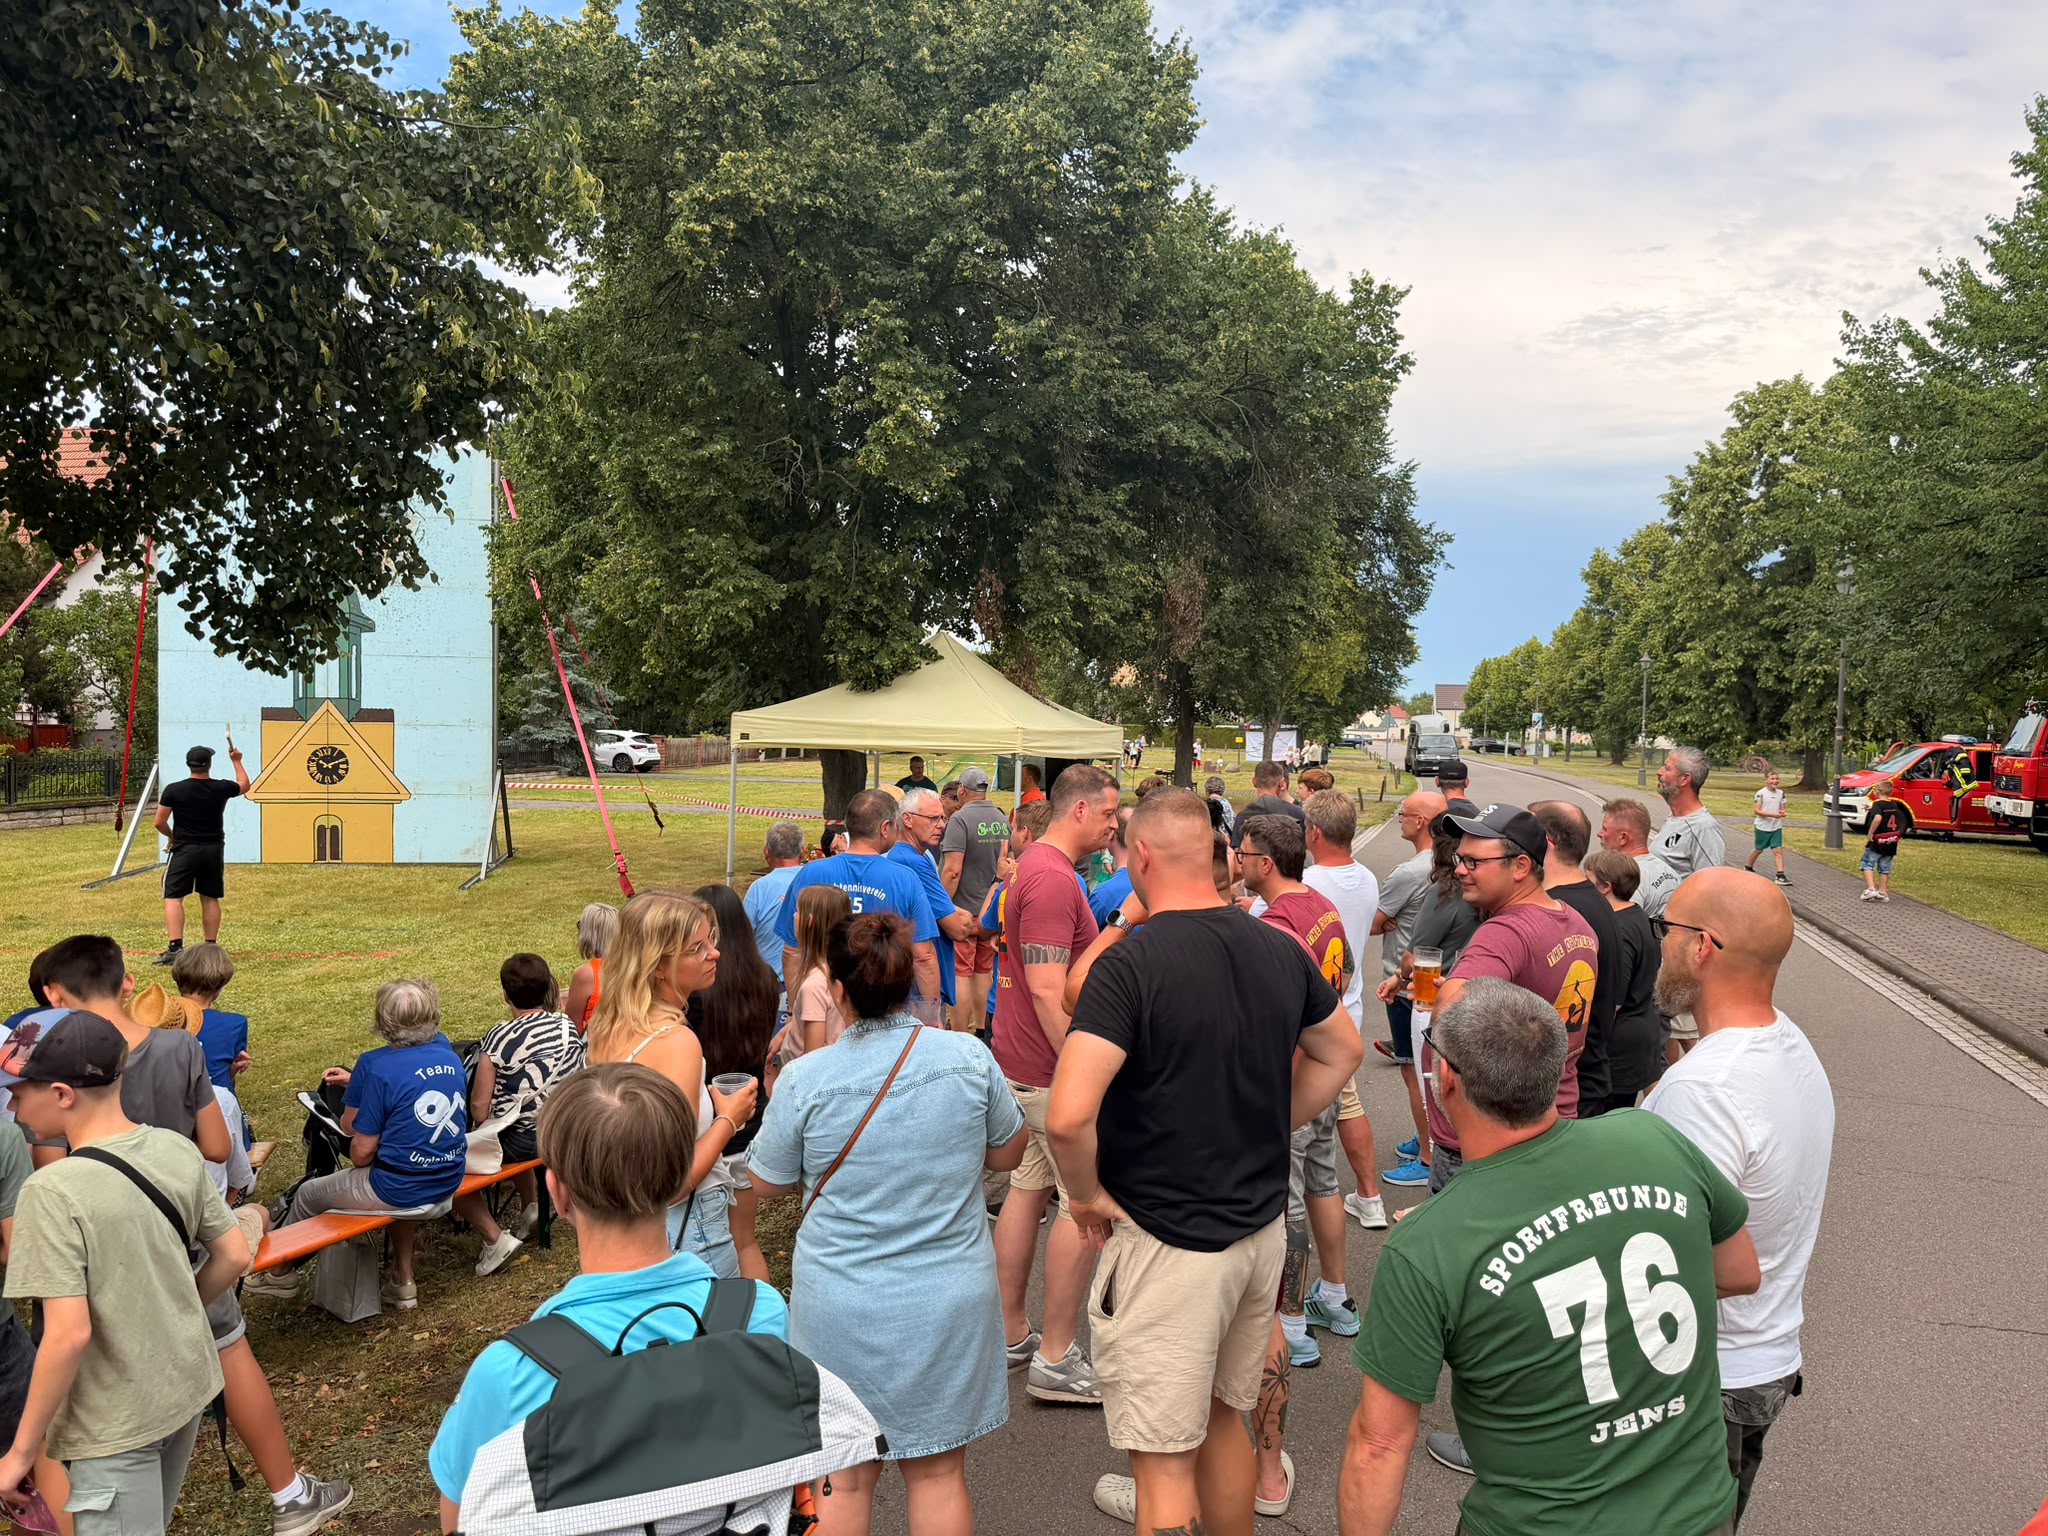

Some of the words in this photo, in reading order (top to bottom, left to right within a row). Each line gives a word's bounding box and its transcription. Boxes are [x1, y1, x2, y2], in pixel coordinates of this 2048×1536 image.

[1886, 814, 1898, 831] 4
[1546, 943, 1566, 967] THE
[415, 1065, 455, 1080] Team
[1479, 1185, 1688, 1297] SPORTFREUNDE
[1532, 1231, 1698, 1405] 76
[1590, 1394, 1686, 1443] JENS
